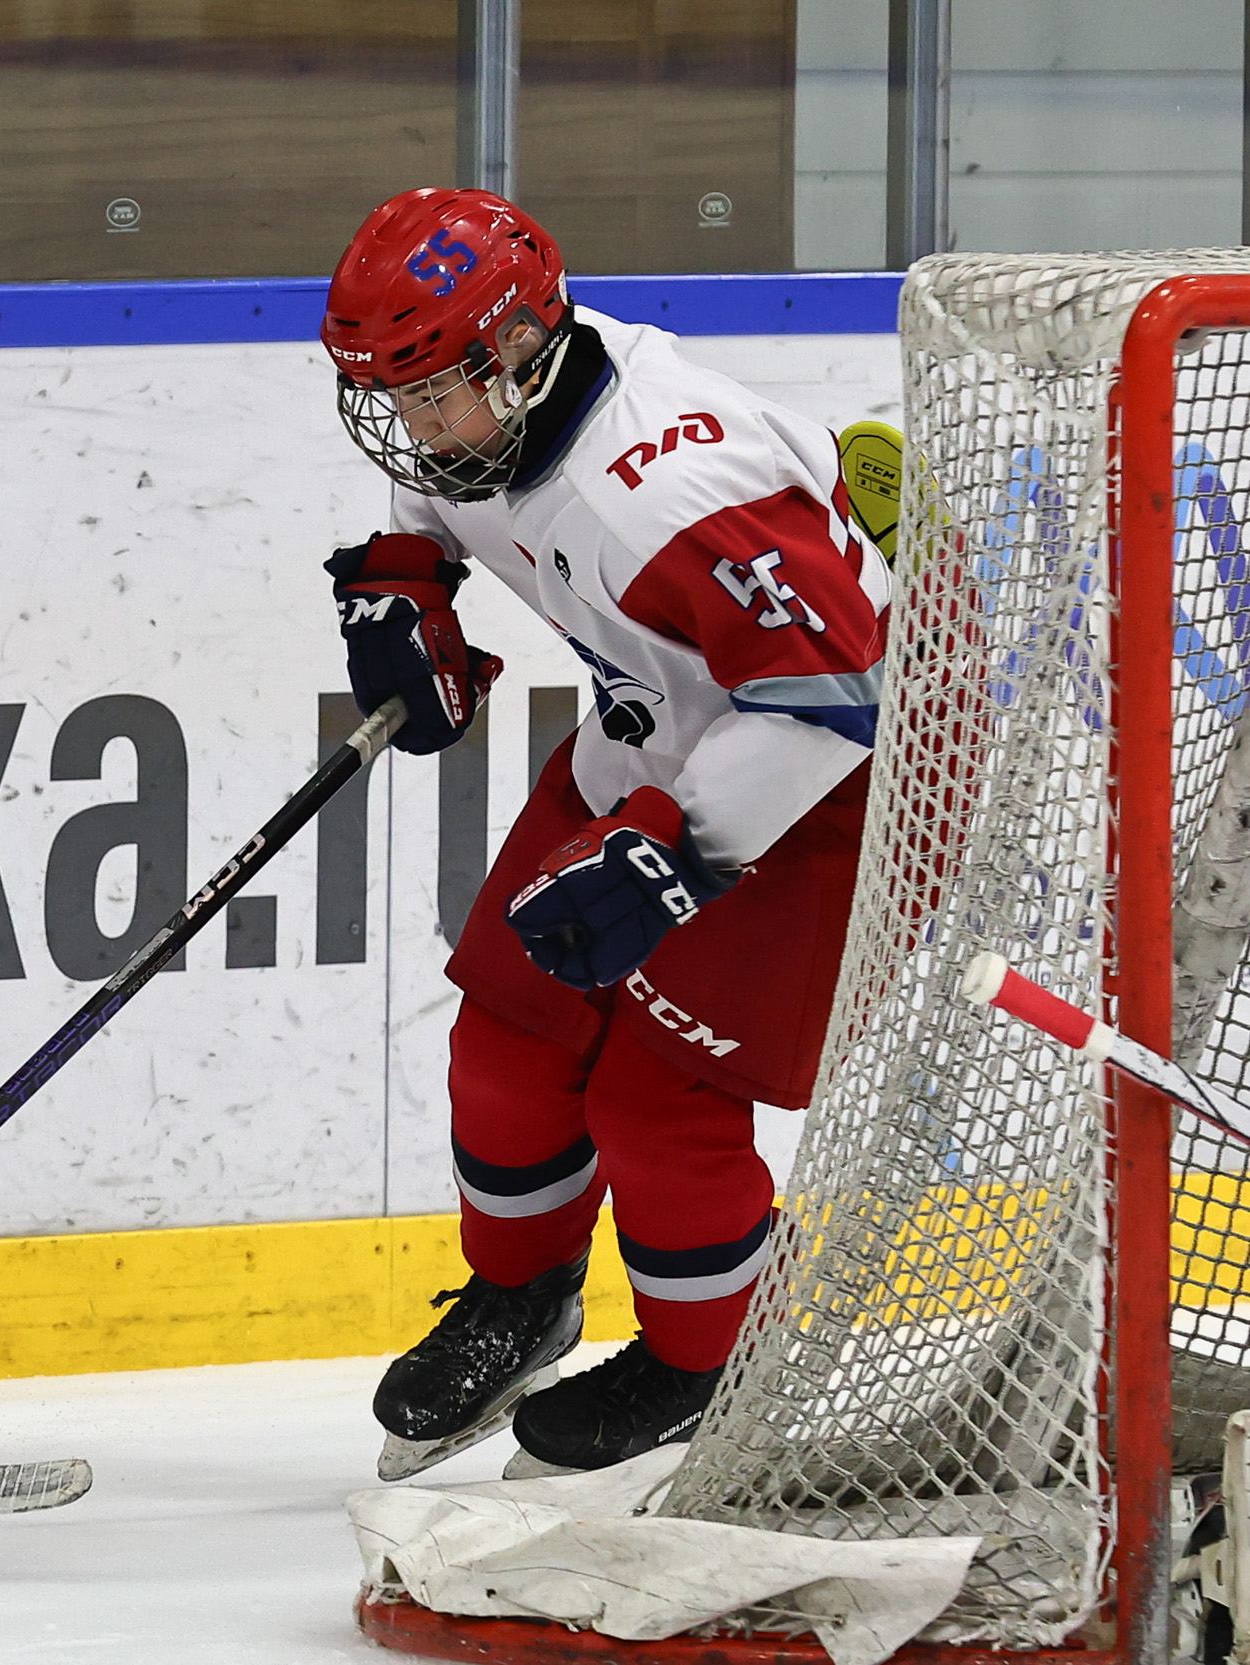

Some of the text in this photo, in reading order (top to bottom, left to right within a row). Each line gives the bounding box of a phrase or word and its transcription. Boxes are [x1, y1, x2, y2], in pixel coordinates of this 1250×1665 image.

[407, 228, 478, 297] 55
[477, 282, 518, 330] CCM
[330, 345, 373, 362] CCM
[861, 461, 896, 480] CCM
[711, 548, 827, 635] 55
[181, 833, 267, 920] CCM
[626, 838, 700, 926] CC
[125, 947, 175, 998] TRIGGER
[626, 967, 742, 1058] CCM
[658, 1410, 703, 1443] BAUER
